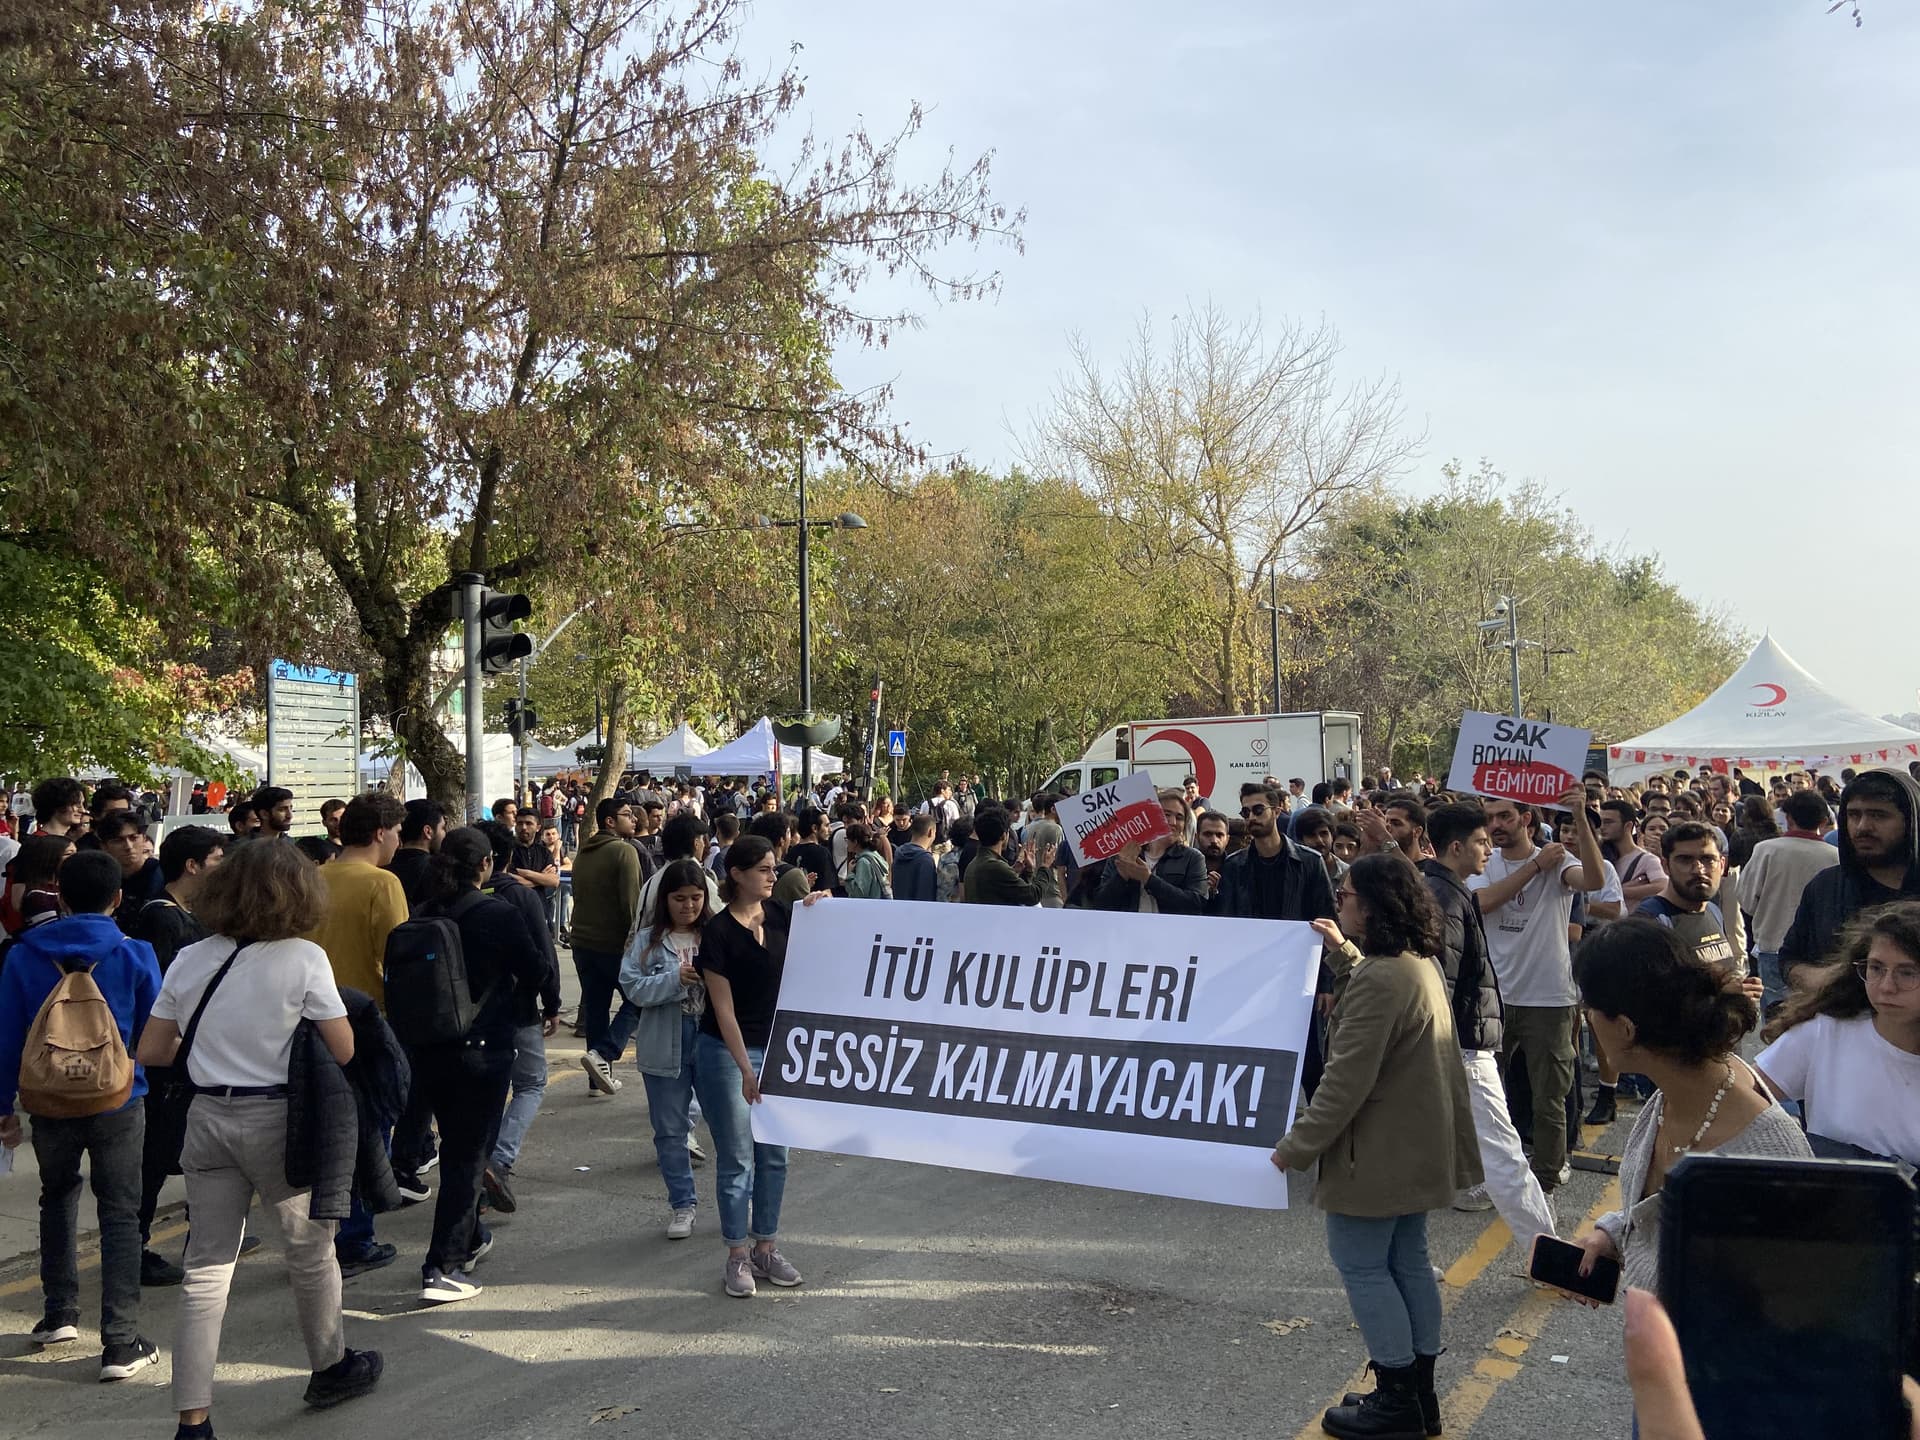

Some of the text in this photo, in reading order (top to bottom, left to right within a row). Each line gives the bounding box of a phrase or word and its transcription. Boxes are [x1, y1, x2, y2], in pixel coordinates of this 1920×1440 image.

[1493, 719, 1551, 749] SAK
[1245, 760, 1269, 768] BAĞIŞI
[1472, 744, 1532, 767] BOYUN
[1484, 767, 1565, 796] EĞMİYOR!
[1081, 785, 1120, 813] SAK
[1075, 808, 1117, 839] BOYUN
[1096, 811, 1152, 854] EĞMİYOR!
[863, 934, 1199, 1023] İTÜ KULÜPLERİ
[780, 1025, 1266, 1128] SESSİZ KALMAYACAK!
